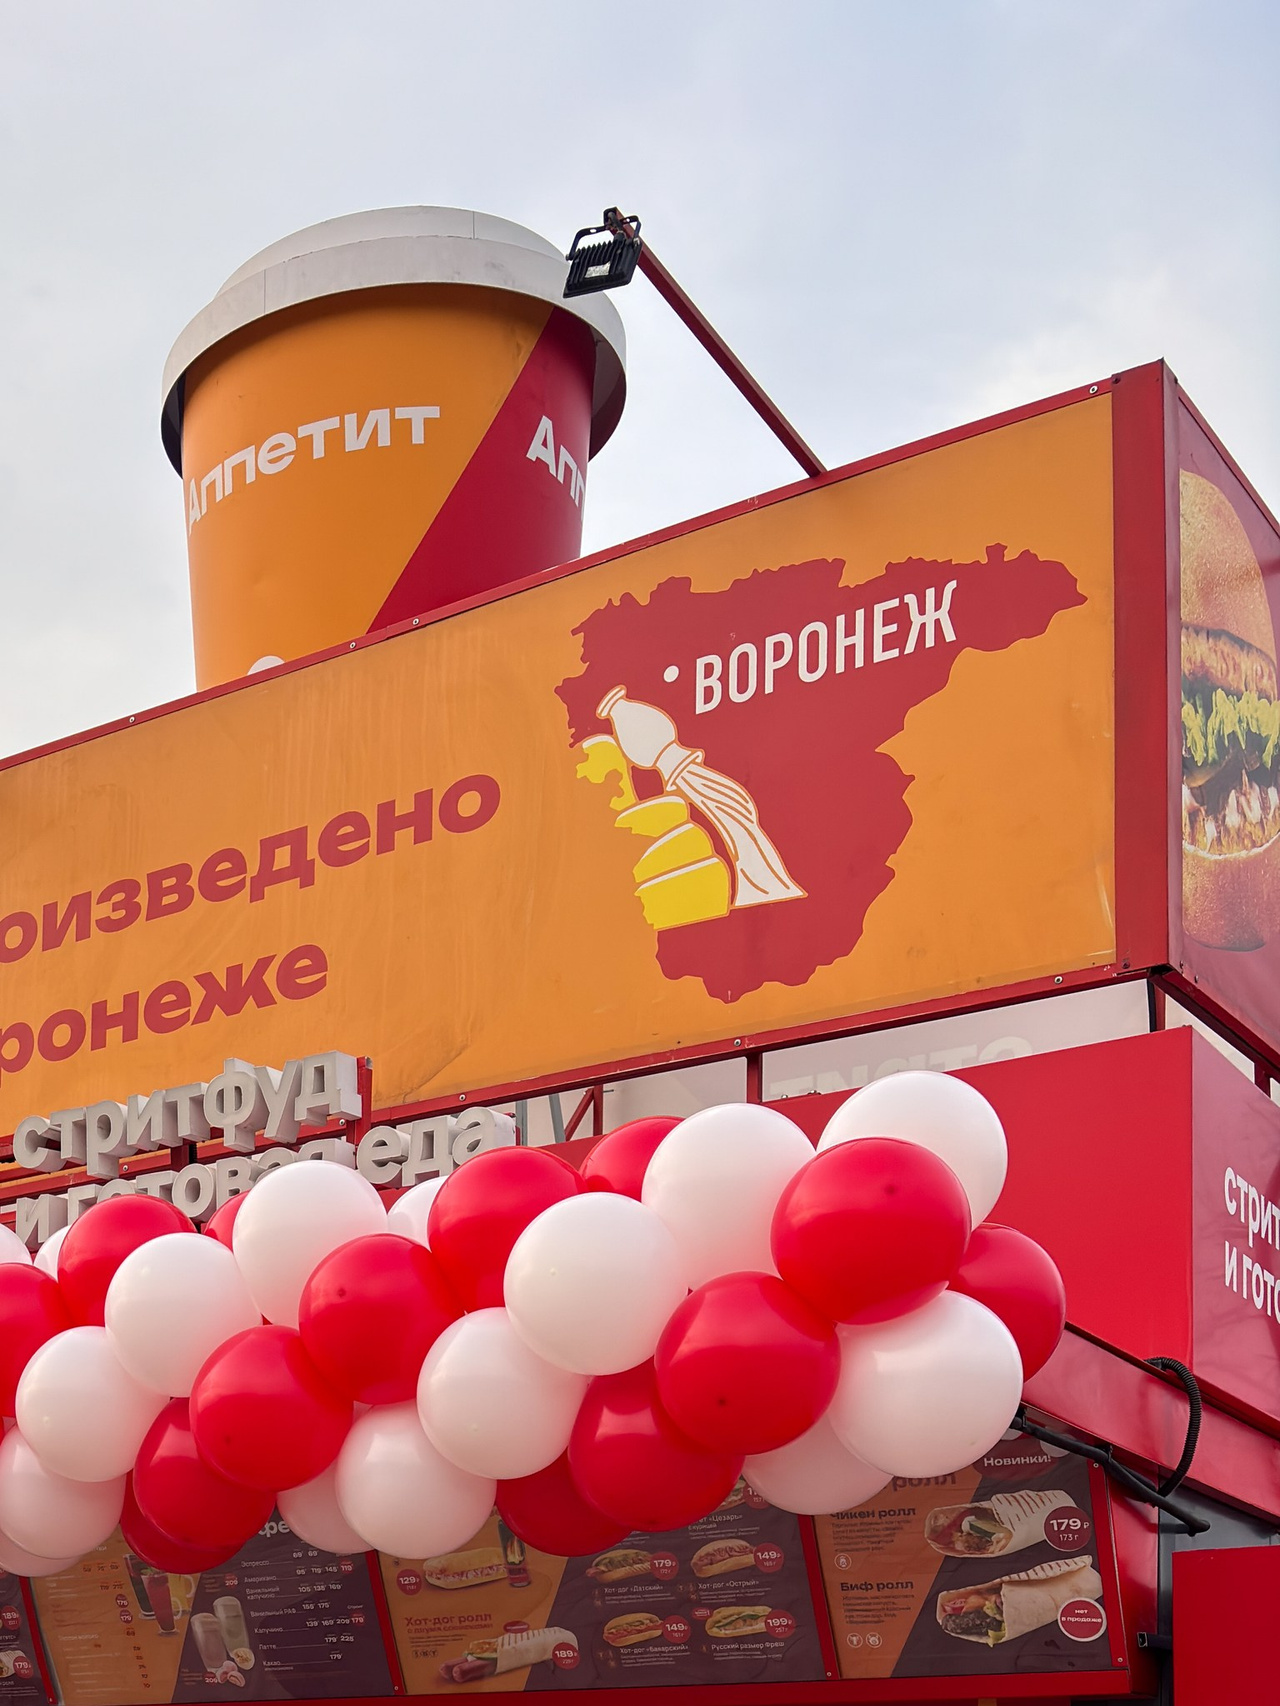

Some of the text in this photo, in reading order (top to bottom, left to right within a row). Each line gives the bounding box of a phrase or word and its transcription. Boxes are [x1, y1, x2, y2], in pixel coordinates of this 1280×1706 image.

[189, 405, 440, 535] Аппетит
[693, 581, 959, 715] ВОРОНЕЖ
[13, 1050, 362, 1179] стритфуд
[356, 1106, 516, 1187] еда
[983, 1453, 1052, 1468] Новинки!
[878, 1506, 916, 1521] ролл
[1059, 1532, 1071, 1541] 173
[241, 1560, 270, 1568] Эспрессо
[244, 1575, 277, 1583] Американо
[840, 1580, 914, 1592] Биф ролл
[458, 1613, 492, 1625] ролл
